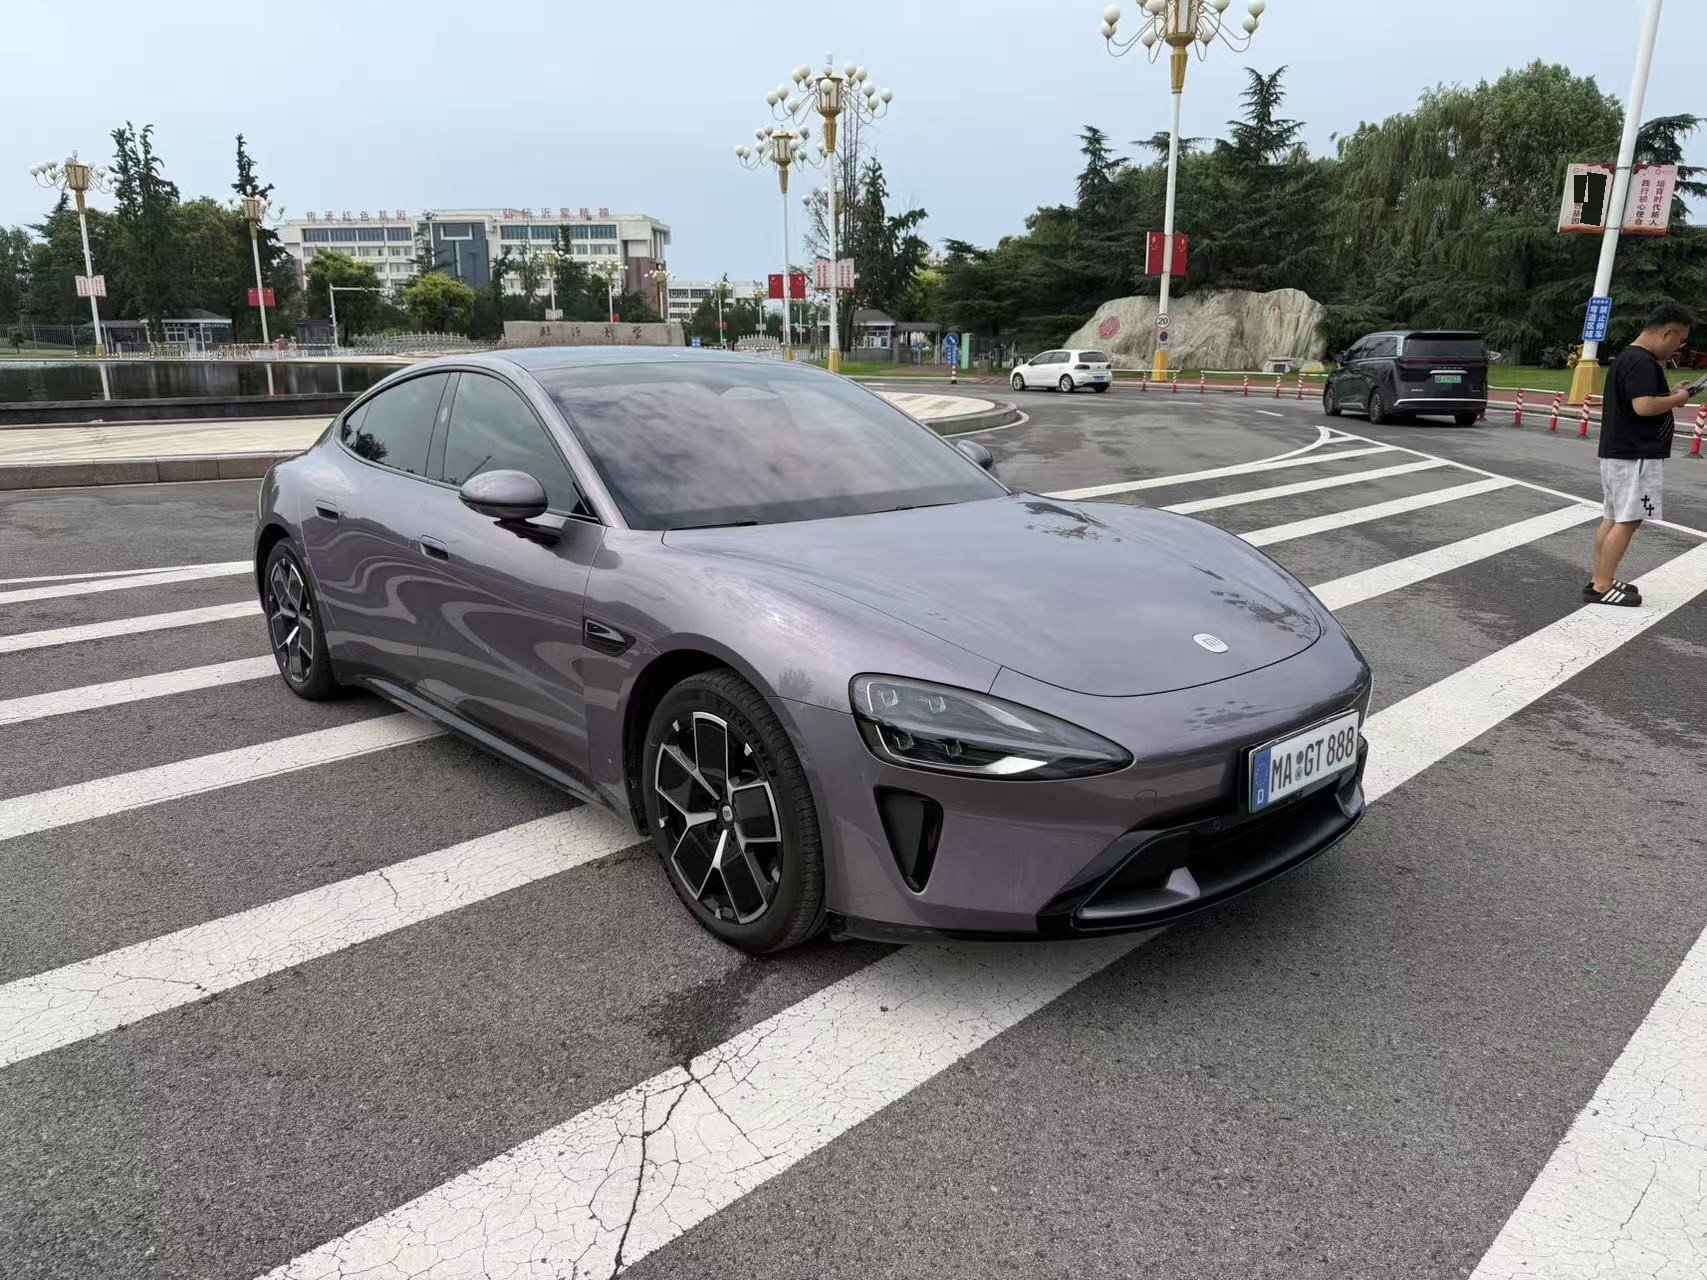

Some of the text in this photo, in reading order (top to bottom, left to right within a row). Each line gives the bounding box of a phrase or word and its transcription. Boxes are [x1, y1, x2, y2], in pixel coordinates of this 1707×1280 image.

[1634, 180, 1650, 225] 践行初心使命
[1649, 180, 1665, 226] 培育时代新人
[1158, 317, 1169, 325] 20
[1594, 305, 1608, 338] 禁止停车
[1271, 726, 1354, 792] MA GT 888
[1257, 788, 1264, 805] D
